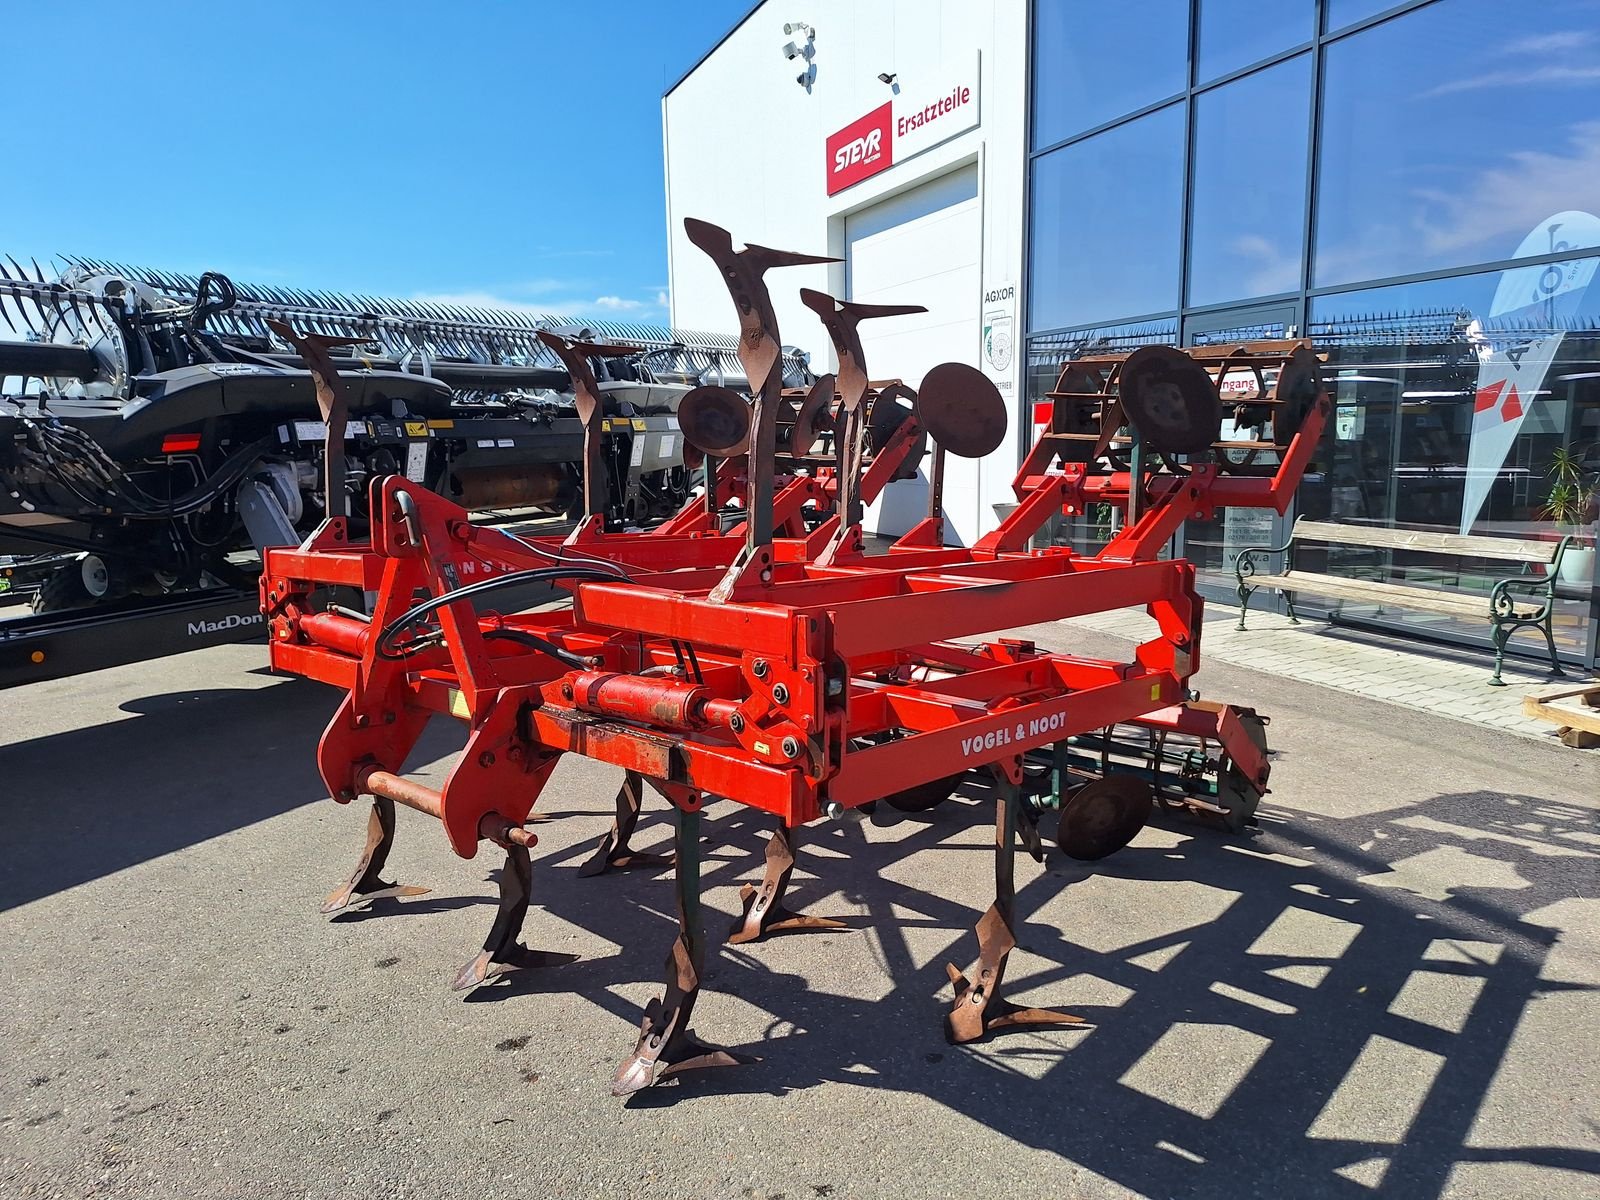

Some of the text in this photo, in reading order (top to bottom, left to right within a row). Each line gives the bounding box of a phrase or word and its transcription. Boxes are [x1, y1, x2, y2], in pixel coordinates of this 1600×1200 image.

[897, 86, 970, 138] Ersatzteile
[834, 128, 882, 173] STEYR
[985, 286, 1014, 304] AGXOR
[994, 381, 1012, 390] ETRIEB
[1214, 379, 1255, 392] ngang
[187, 614, 263, 636] MacDon
[961, 711, 1066, 757] VOGEL & NOOT
